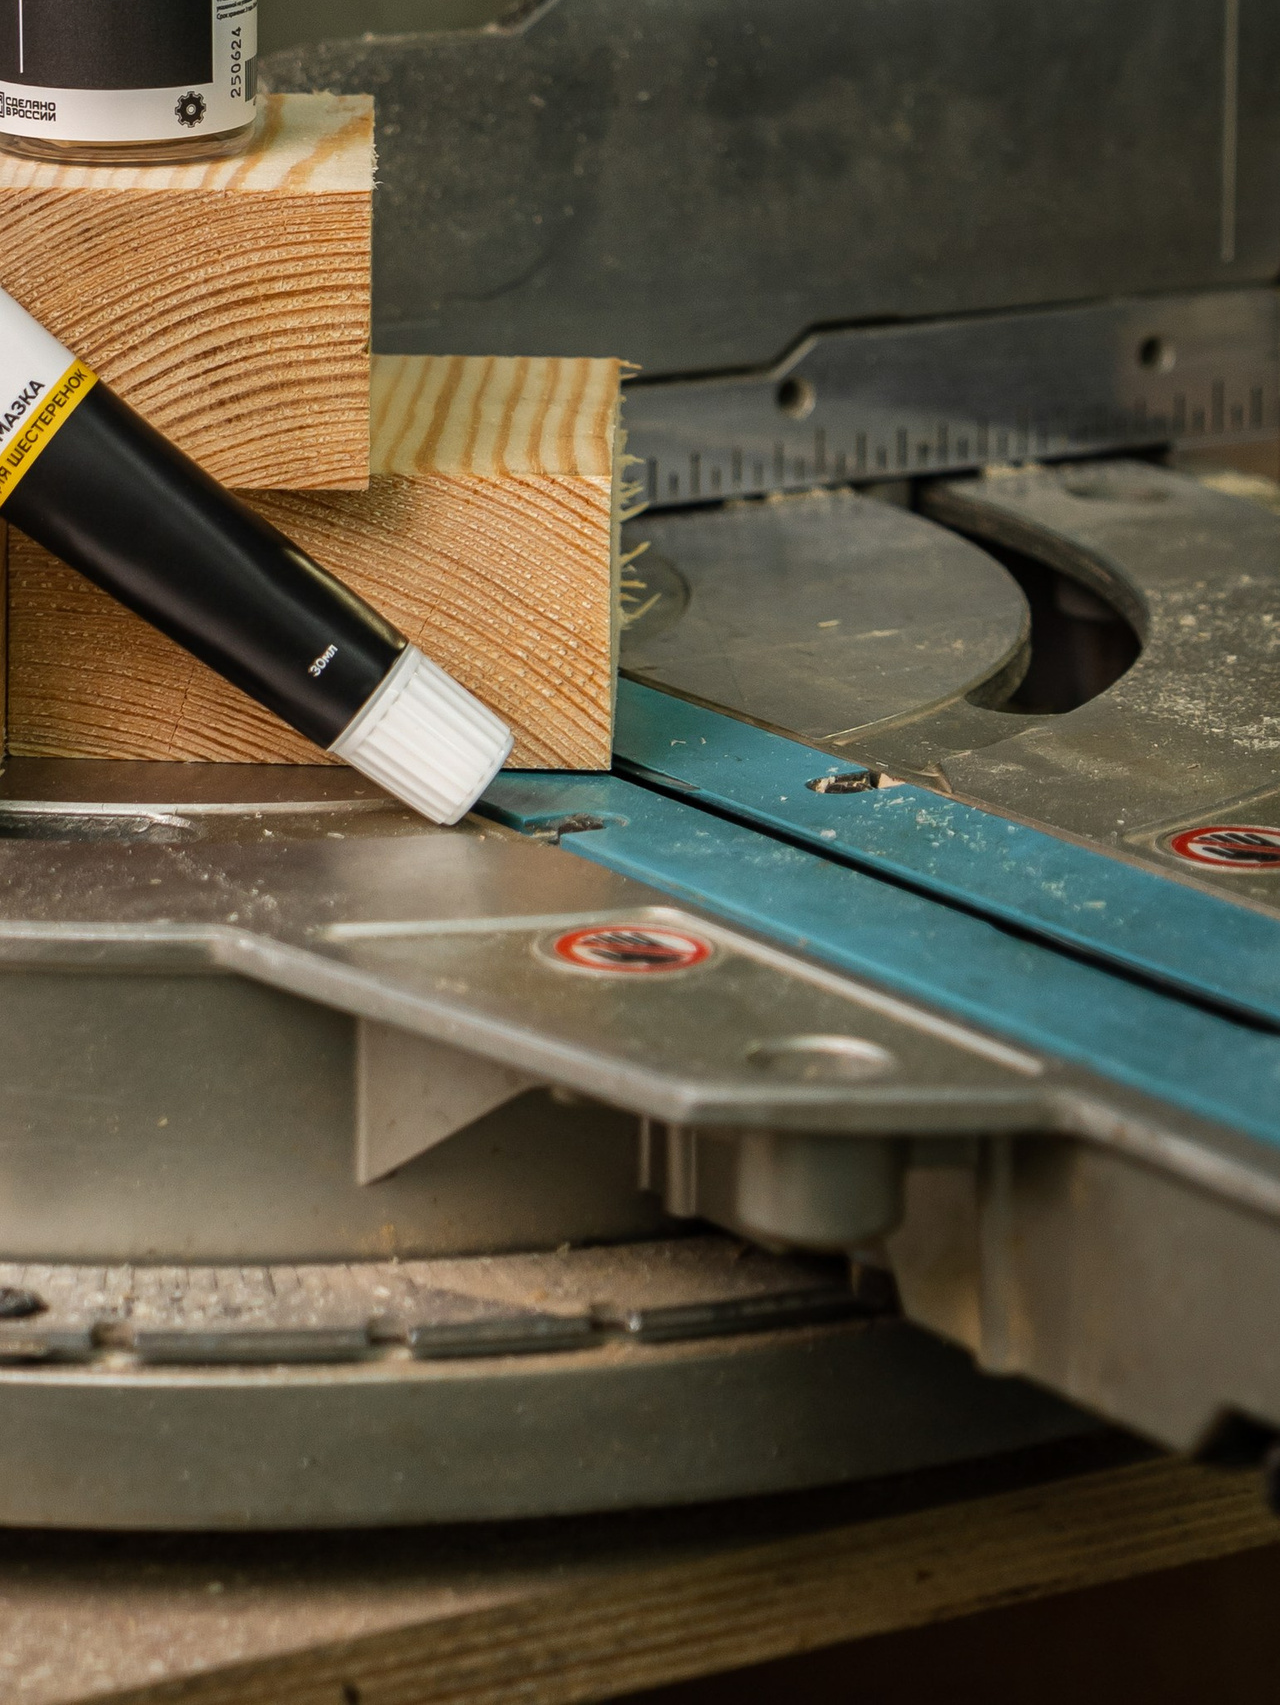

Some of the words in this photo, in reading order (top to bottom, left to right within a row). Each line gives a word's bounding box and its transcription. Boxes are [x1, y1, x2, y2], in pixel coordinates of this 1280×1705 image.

[230, 26, 242, 99] 250624
[5, 96, 57, 112] СДЕЛАНО
[6, 368, 88, 468] ШЕСТЕРЕНОК
[308, 644, 339, 678] 30мл
